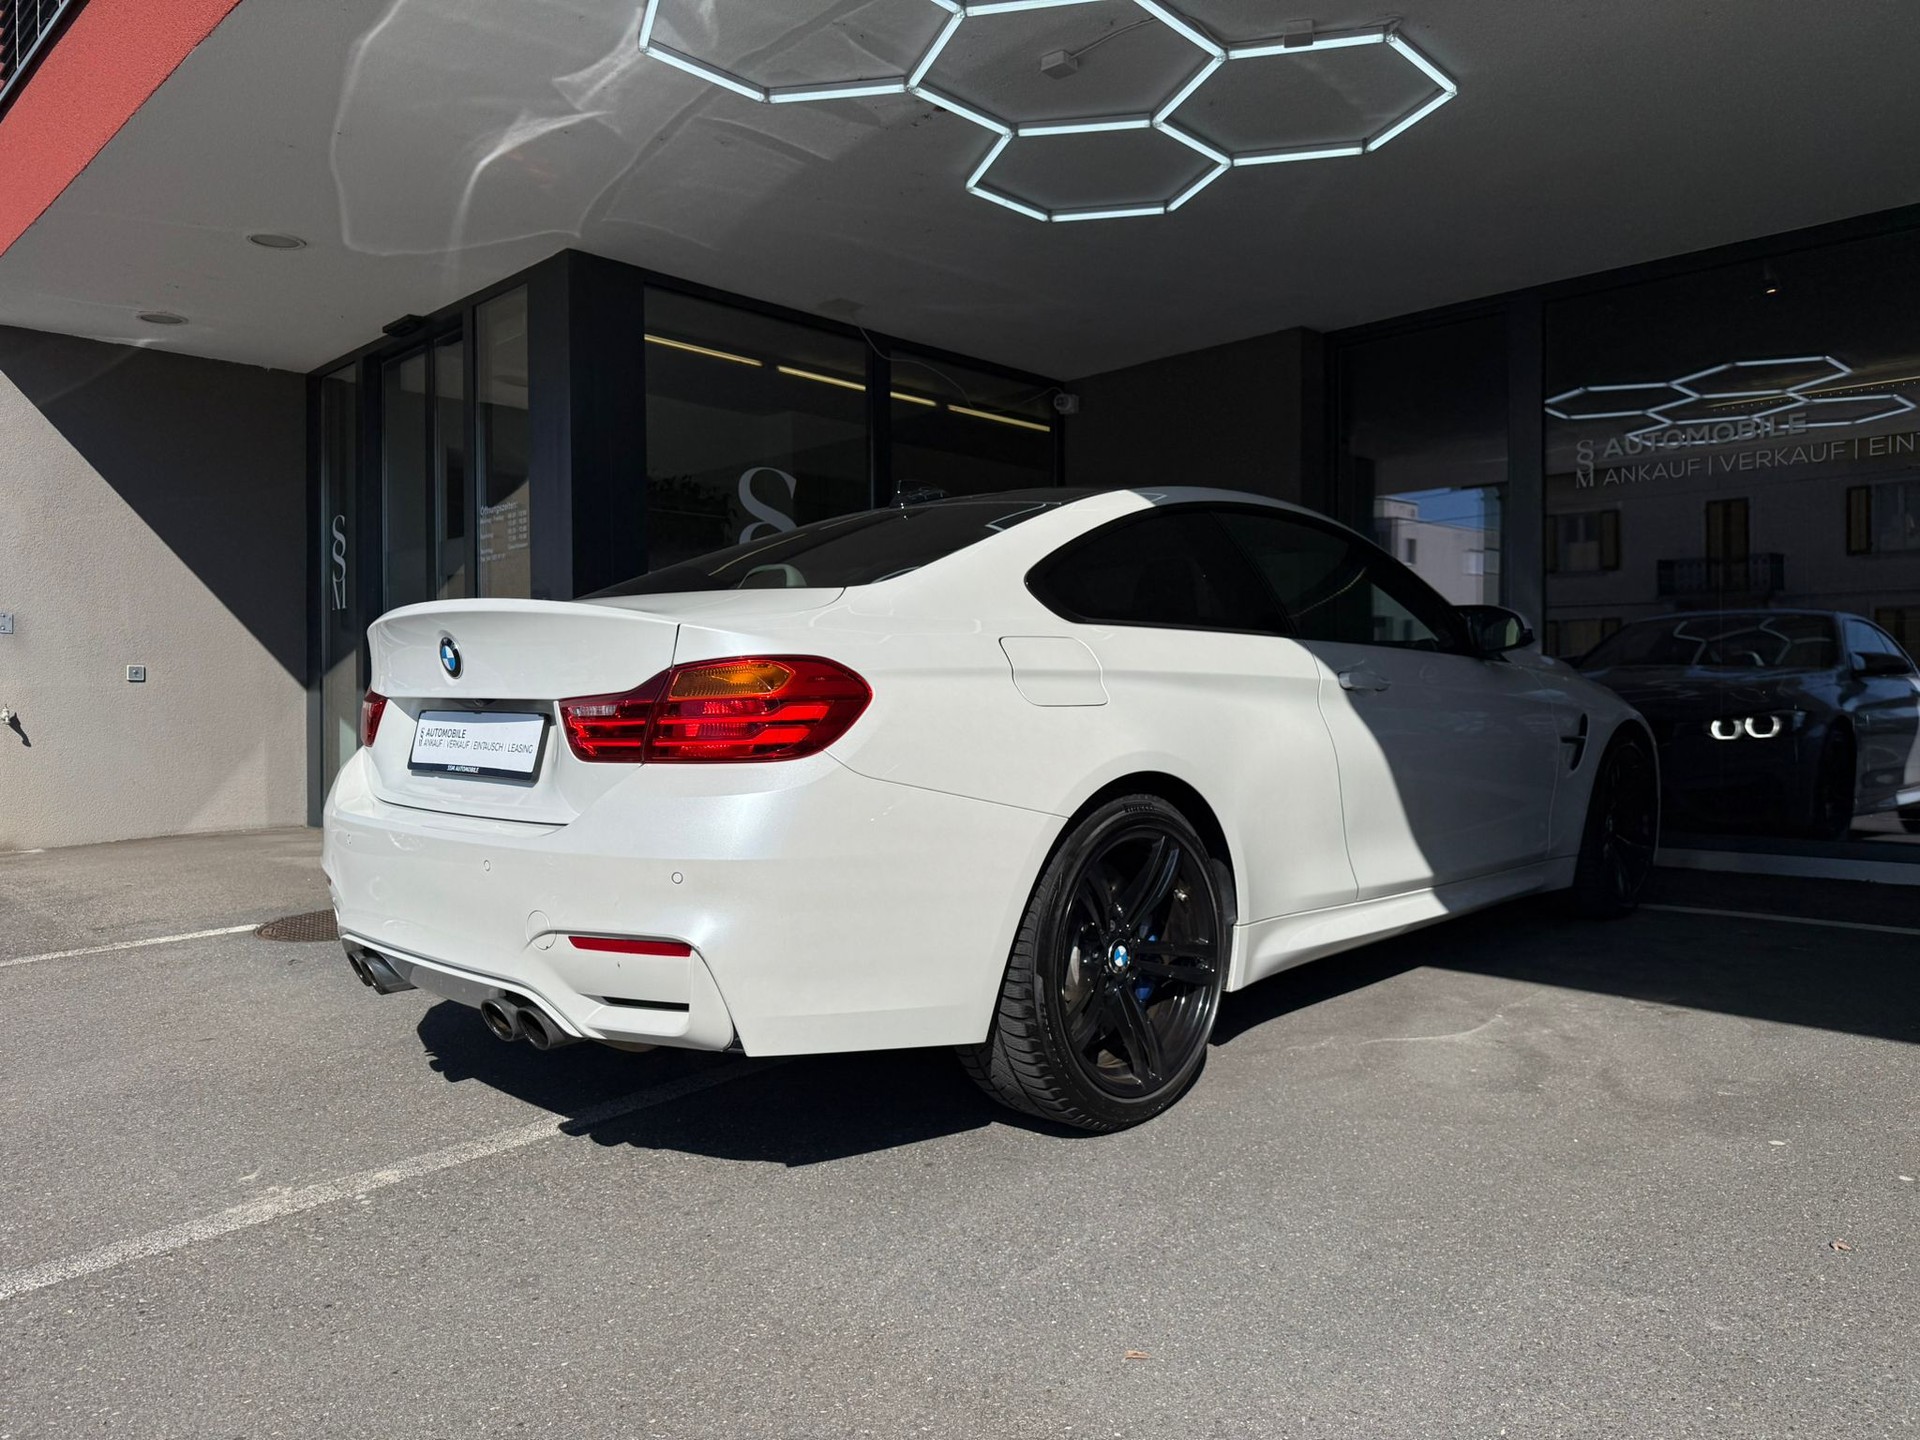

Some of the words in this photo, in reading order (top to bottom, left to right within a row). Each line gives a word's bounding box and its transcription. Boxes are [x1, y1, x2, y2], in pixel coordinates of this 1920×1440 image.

[1603, 412, 1807, 458] AUTOMOBILE
[1603, 457, 1701, 486] ANKAUF
[1719, 441, 1846, 472] VERKAUF
[426, 728, 467, 739] AUTOMOBILE
[507, 743, 533, 754] LEASING
